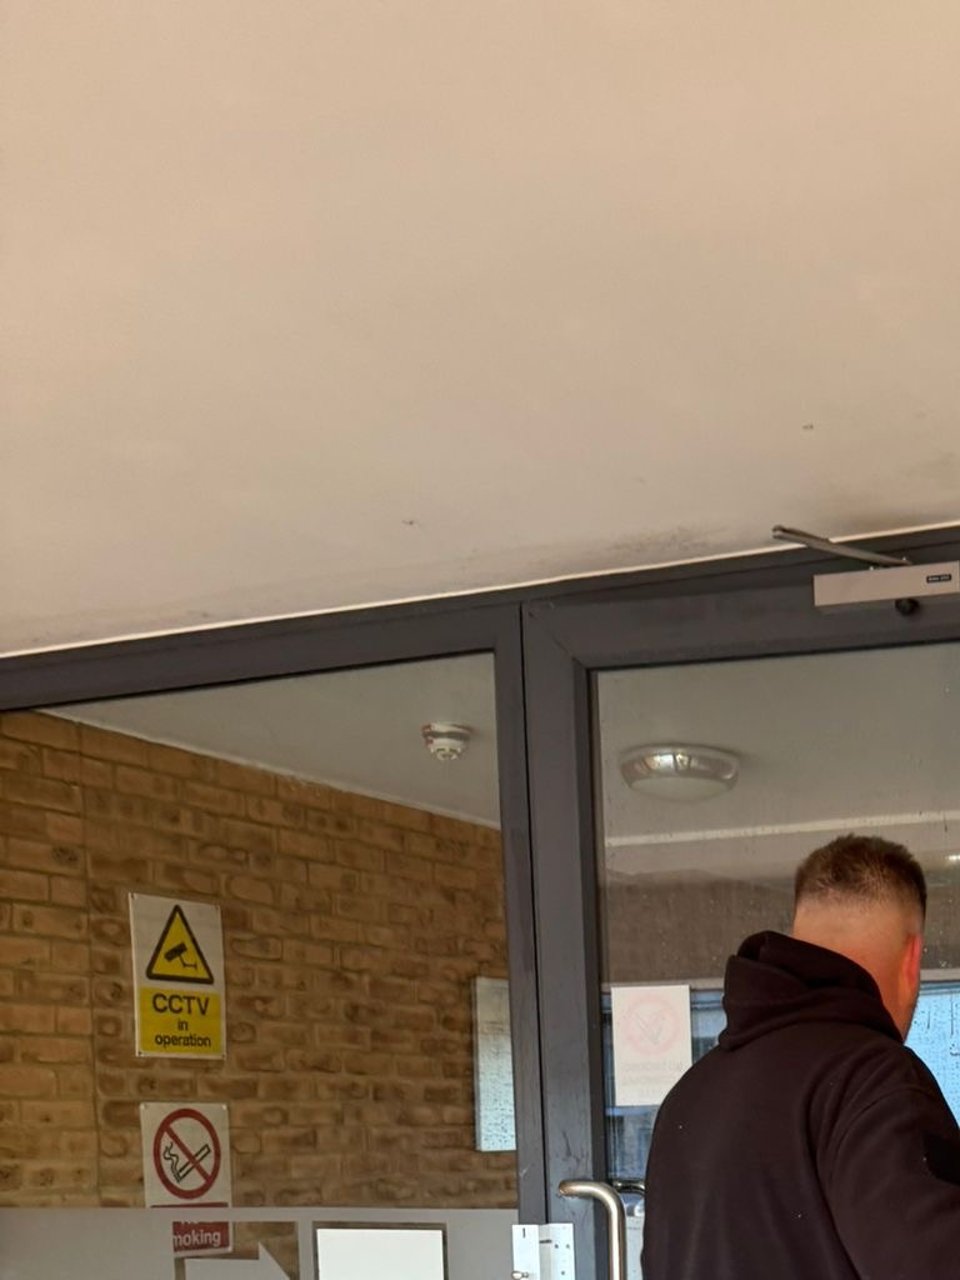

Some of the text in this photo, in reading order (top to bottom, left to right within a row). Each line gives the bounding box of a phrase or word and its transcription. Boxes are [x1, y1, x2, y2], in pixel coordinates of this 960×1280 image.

[152, 993, 210, 1015] CCTV
[177, 1019, 189, 1031] in
[154, 1033, 212, 1048] operation
[171, 1228, 221, 1248] moking
